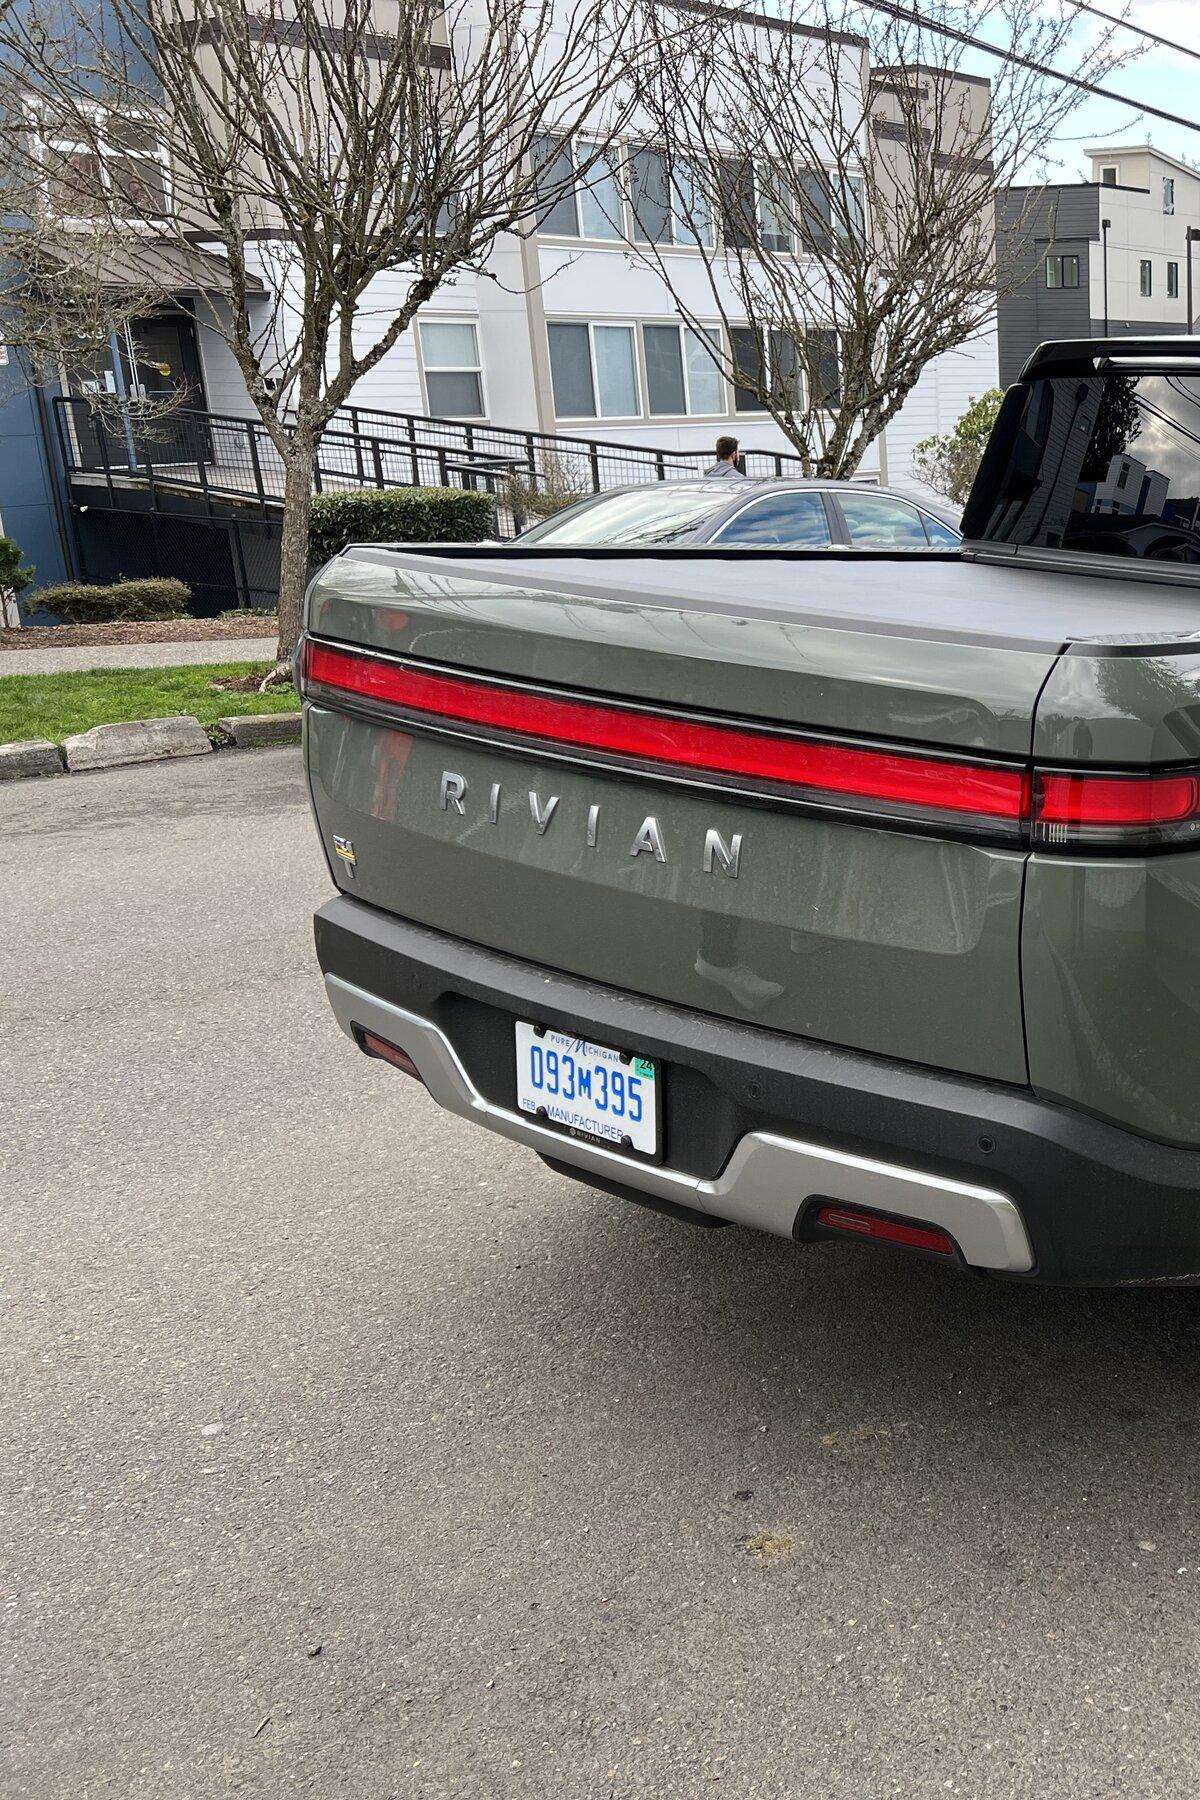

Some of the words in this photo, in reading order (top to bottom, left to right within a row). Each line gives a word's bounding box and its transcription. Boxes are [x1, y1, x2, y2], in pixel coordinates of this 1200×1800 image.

[439, 770, 743, 879] RIVIAN
[550, 1034, 571, 1048] PURE
[566, 1038, 620, 1063] MICHIGAN
[530, 1045, 643, 1123] 093M395
[522, 1097, 536, 1111] FEB
[547, 1104, 624, 1141] MANUFACTURER
